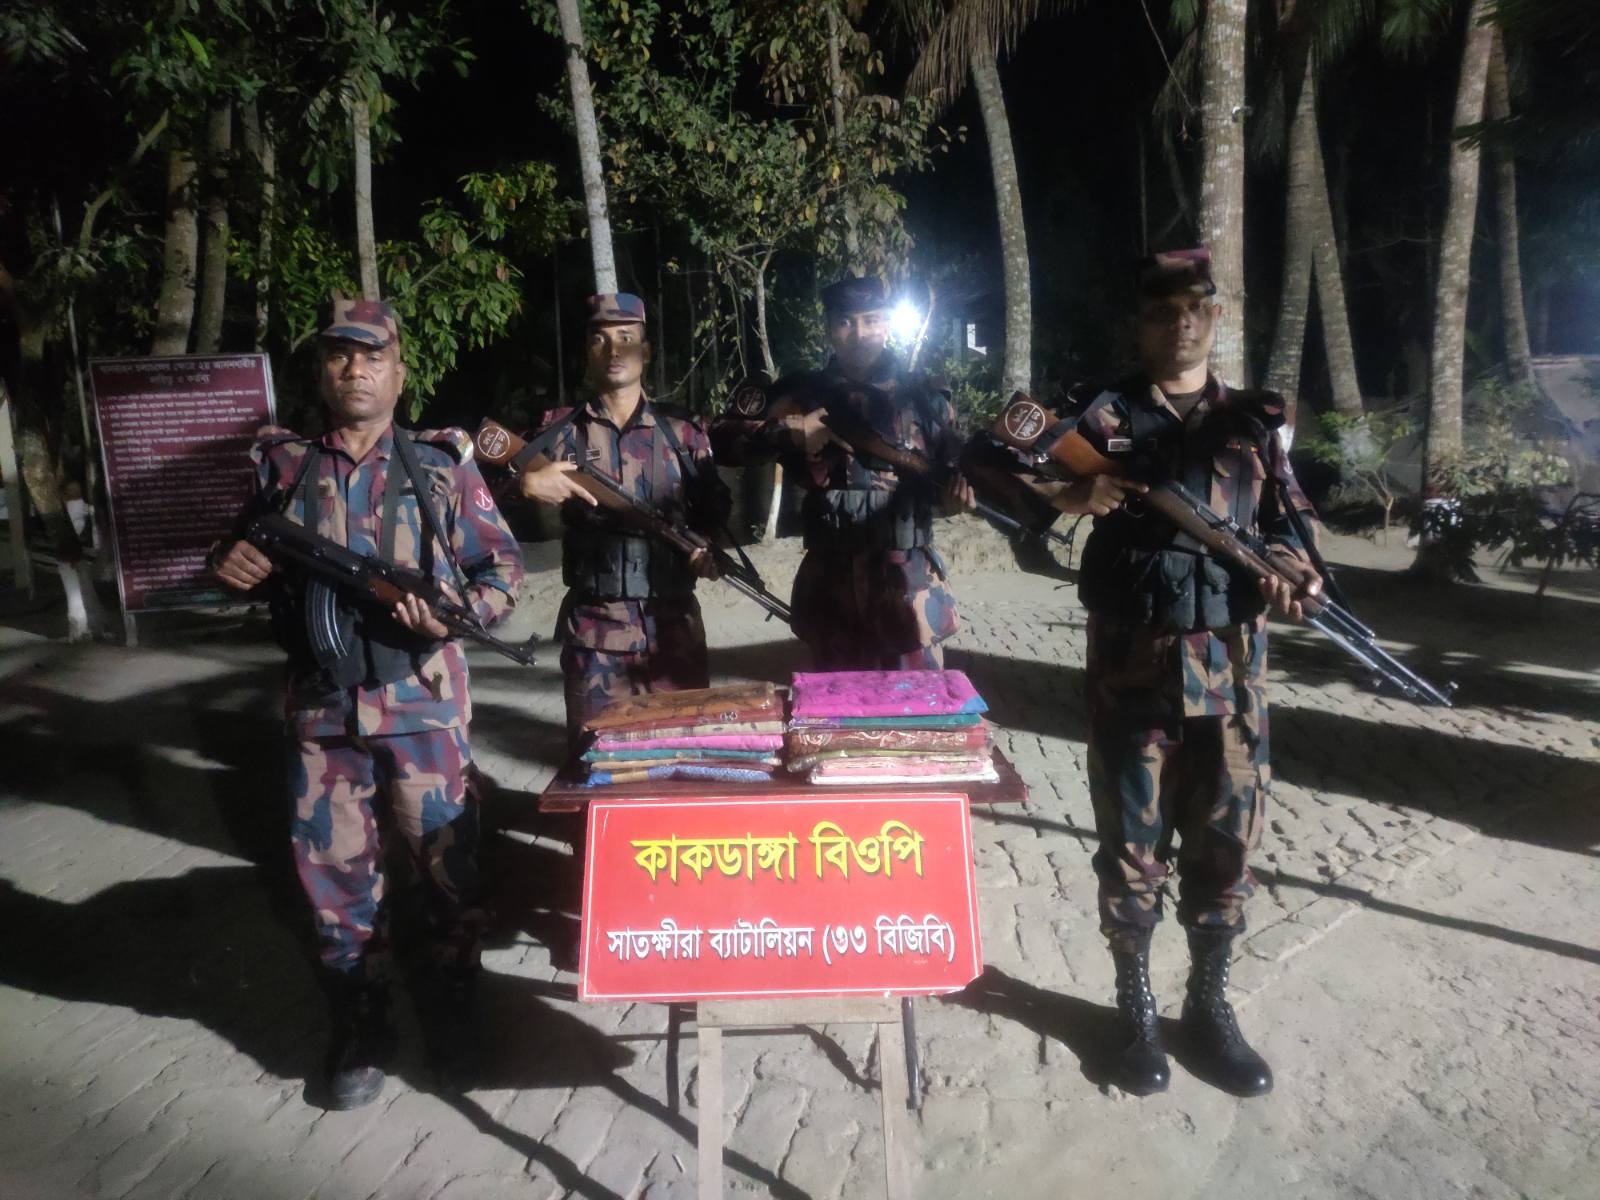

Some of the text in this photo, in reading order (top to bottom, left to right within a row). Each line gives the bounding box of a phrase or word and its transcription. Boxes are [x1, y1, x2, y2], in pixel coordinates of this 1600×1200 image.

[631, 820, 925, 882] কাকডাঙ্গা বিওপি
[607, 914, 955, 965] সাতক্ষীরা ব্যাটালিয়ন (৩৩ বিজিবি)
